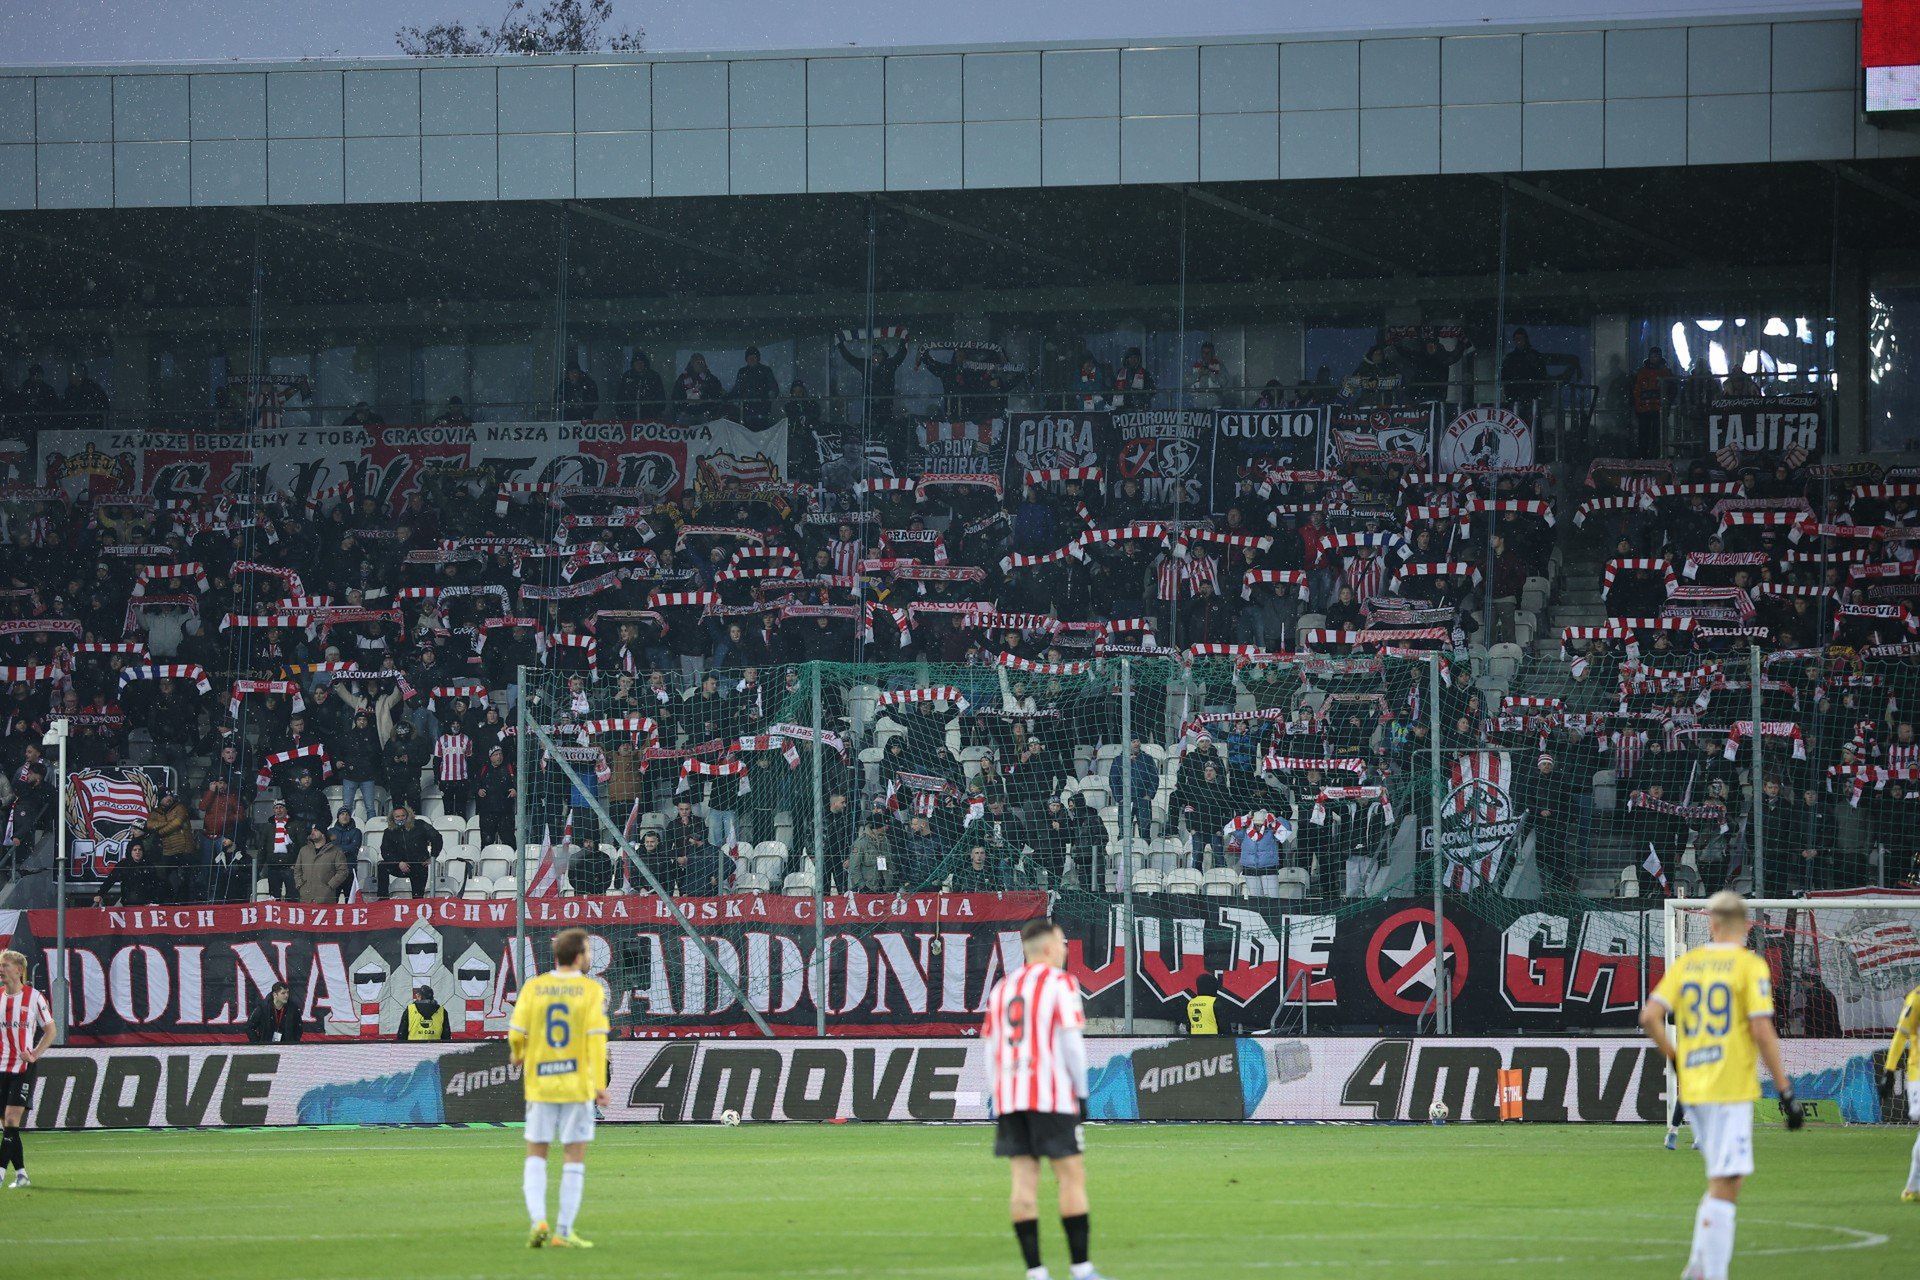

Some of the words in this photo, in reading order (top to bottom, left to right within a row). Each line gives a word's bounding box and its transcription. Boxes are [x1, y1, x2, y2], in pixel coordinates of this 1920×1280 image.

[1112, 411, 1212, 428] POZDROWIENIA
[1220, 413, 1314, 437] GUCIO
[111, 434, 187, 449] ZAWSZE
[195, 432, 289, 450] BĘDZIEMY
[297, 432, 308, 446] Z
[383, 428, 477, 443] CRACOVIA
[1018, 415, 1095, 455] GÓRA
[1122, 427, 1137, 440] DO
[1709, 412, 1819, 452] FAJTER
[924, 457, 989, 474] FIGURKA
[807, 513, 837, 524] ARKA
[851, 511, 873, 523] PAS
[462, 537, 507, 546] RACOVIA
[887, 530, 937, 541] CRACOVI
[1103, 644, 1151, 653] RACOVIA
[1738, 721, 1792, 735] CRCOVIA
[90, 781, 107, 794] KS
[97, 800, 144, 813] CRACOVIA
[109, 909, 215, 930] NIECH
[394, 900, 628, 922] POCHWALONA
[655, 899, 766, 920] BOSKA
[795, 898, 974, 919] CRACOVIA
[1066, 904, 1337, 1007] JUDE
[45, 940, 359, 1026] DOLNA
[1681, 982, 1732, 1037] 39
[546, 1003, 570, 1048] 6
[1008, 996, 1026, 1047] 9
[22, 1053, 280, 1127] MOVE
[446, 1063, 522, 1097] 4MOV
[628, 1043, 967, 1122] 4MOVE
[1503, 1085, 1522, 1102] STIHL
